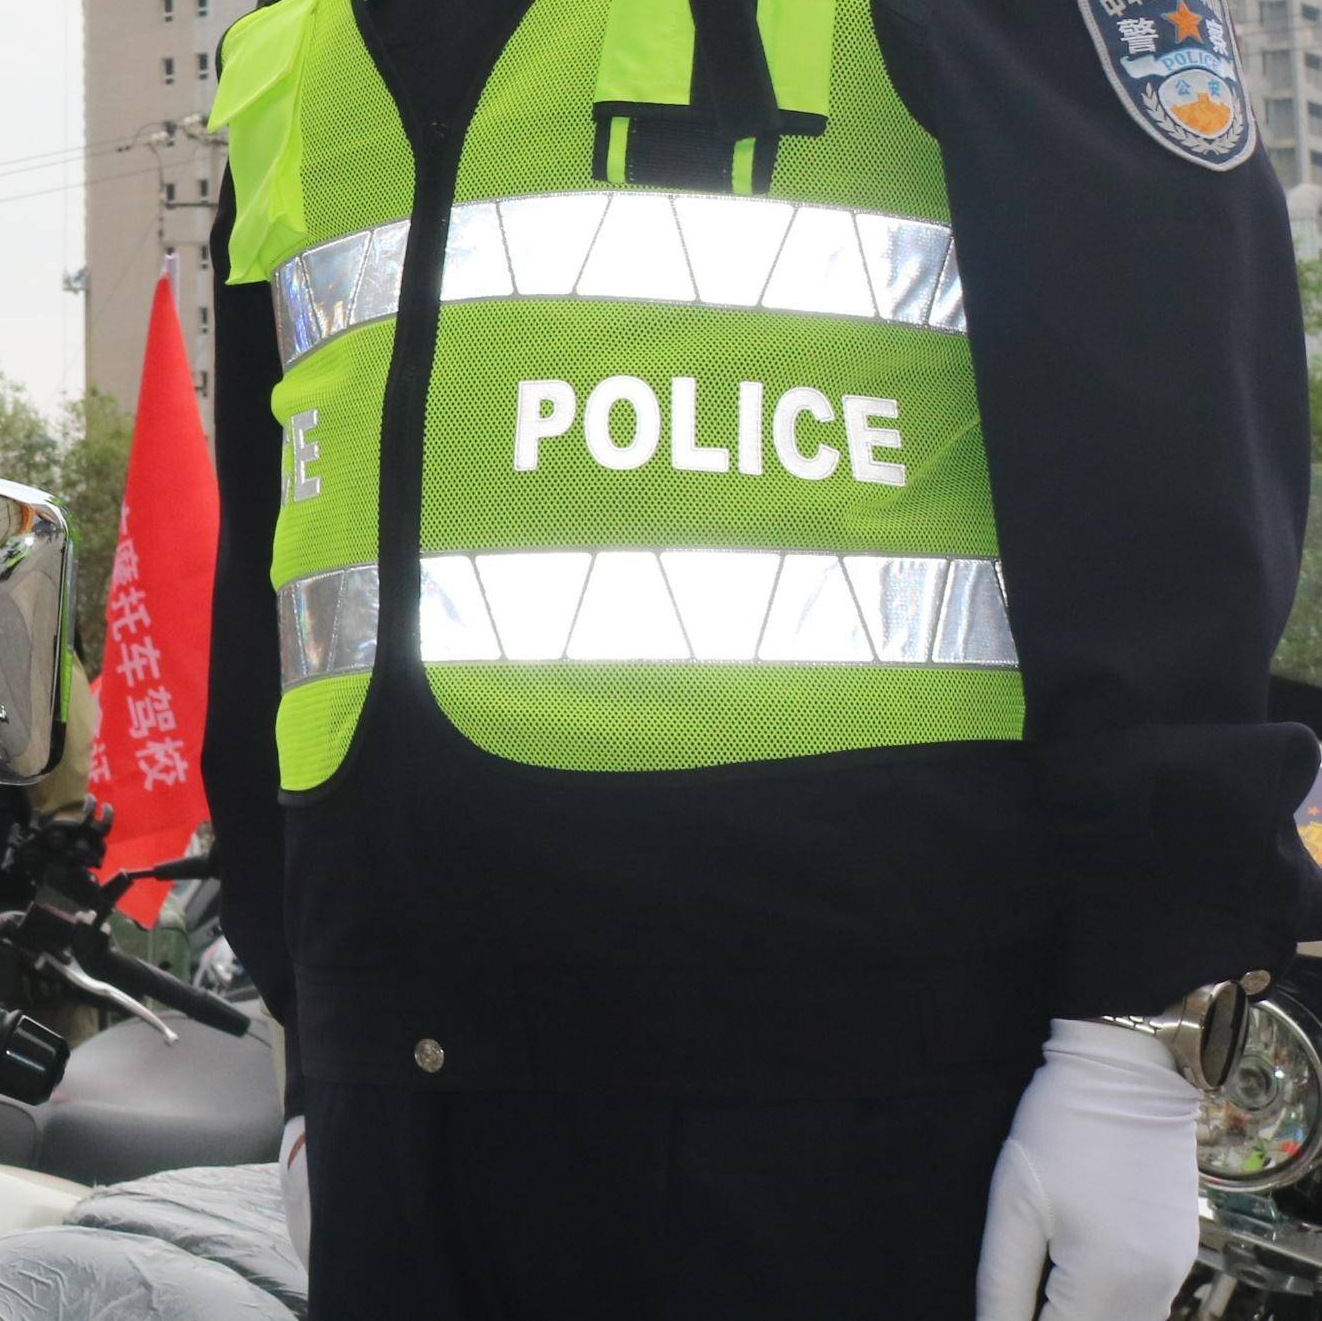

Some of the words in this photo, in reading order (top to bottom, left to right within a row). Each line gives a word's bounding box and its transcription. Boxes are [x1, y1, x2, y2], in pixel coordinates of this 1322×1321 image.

[1162, 49, 1218, 71] POLICE
[282, 408, 321, 506] E
[513, 375, 906, 487] POLICE
[111, 501, 189, 791] 摩托车驾校
